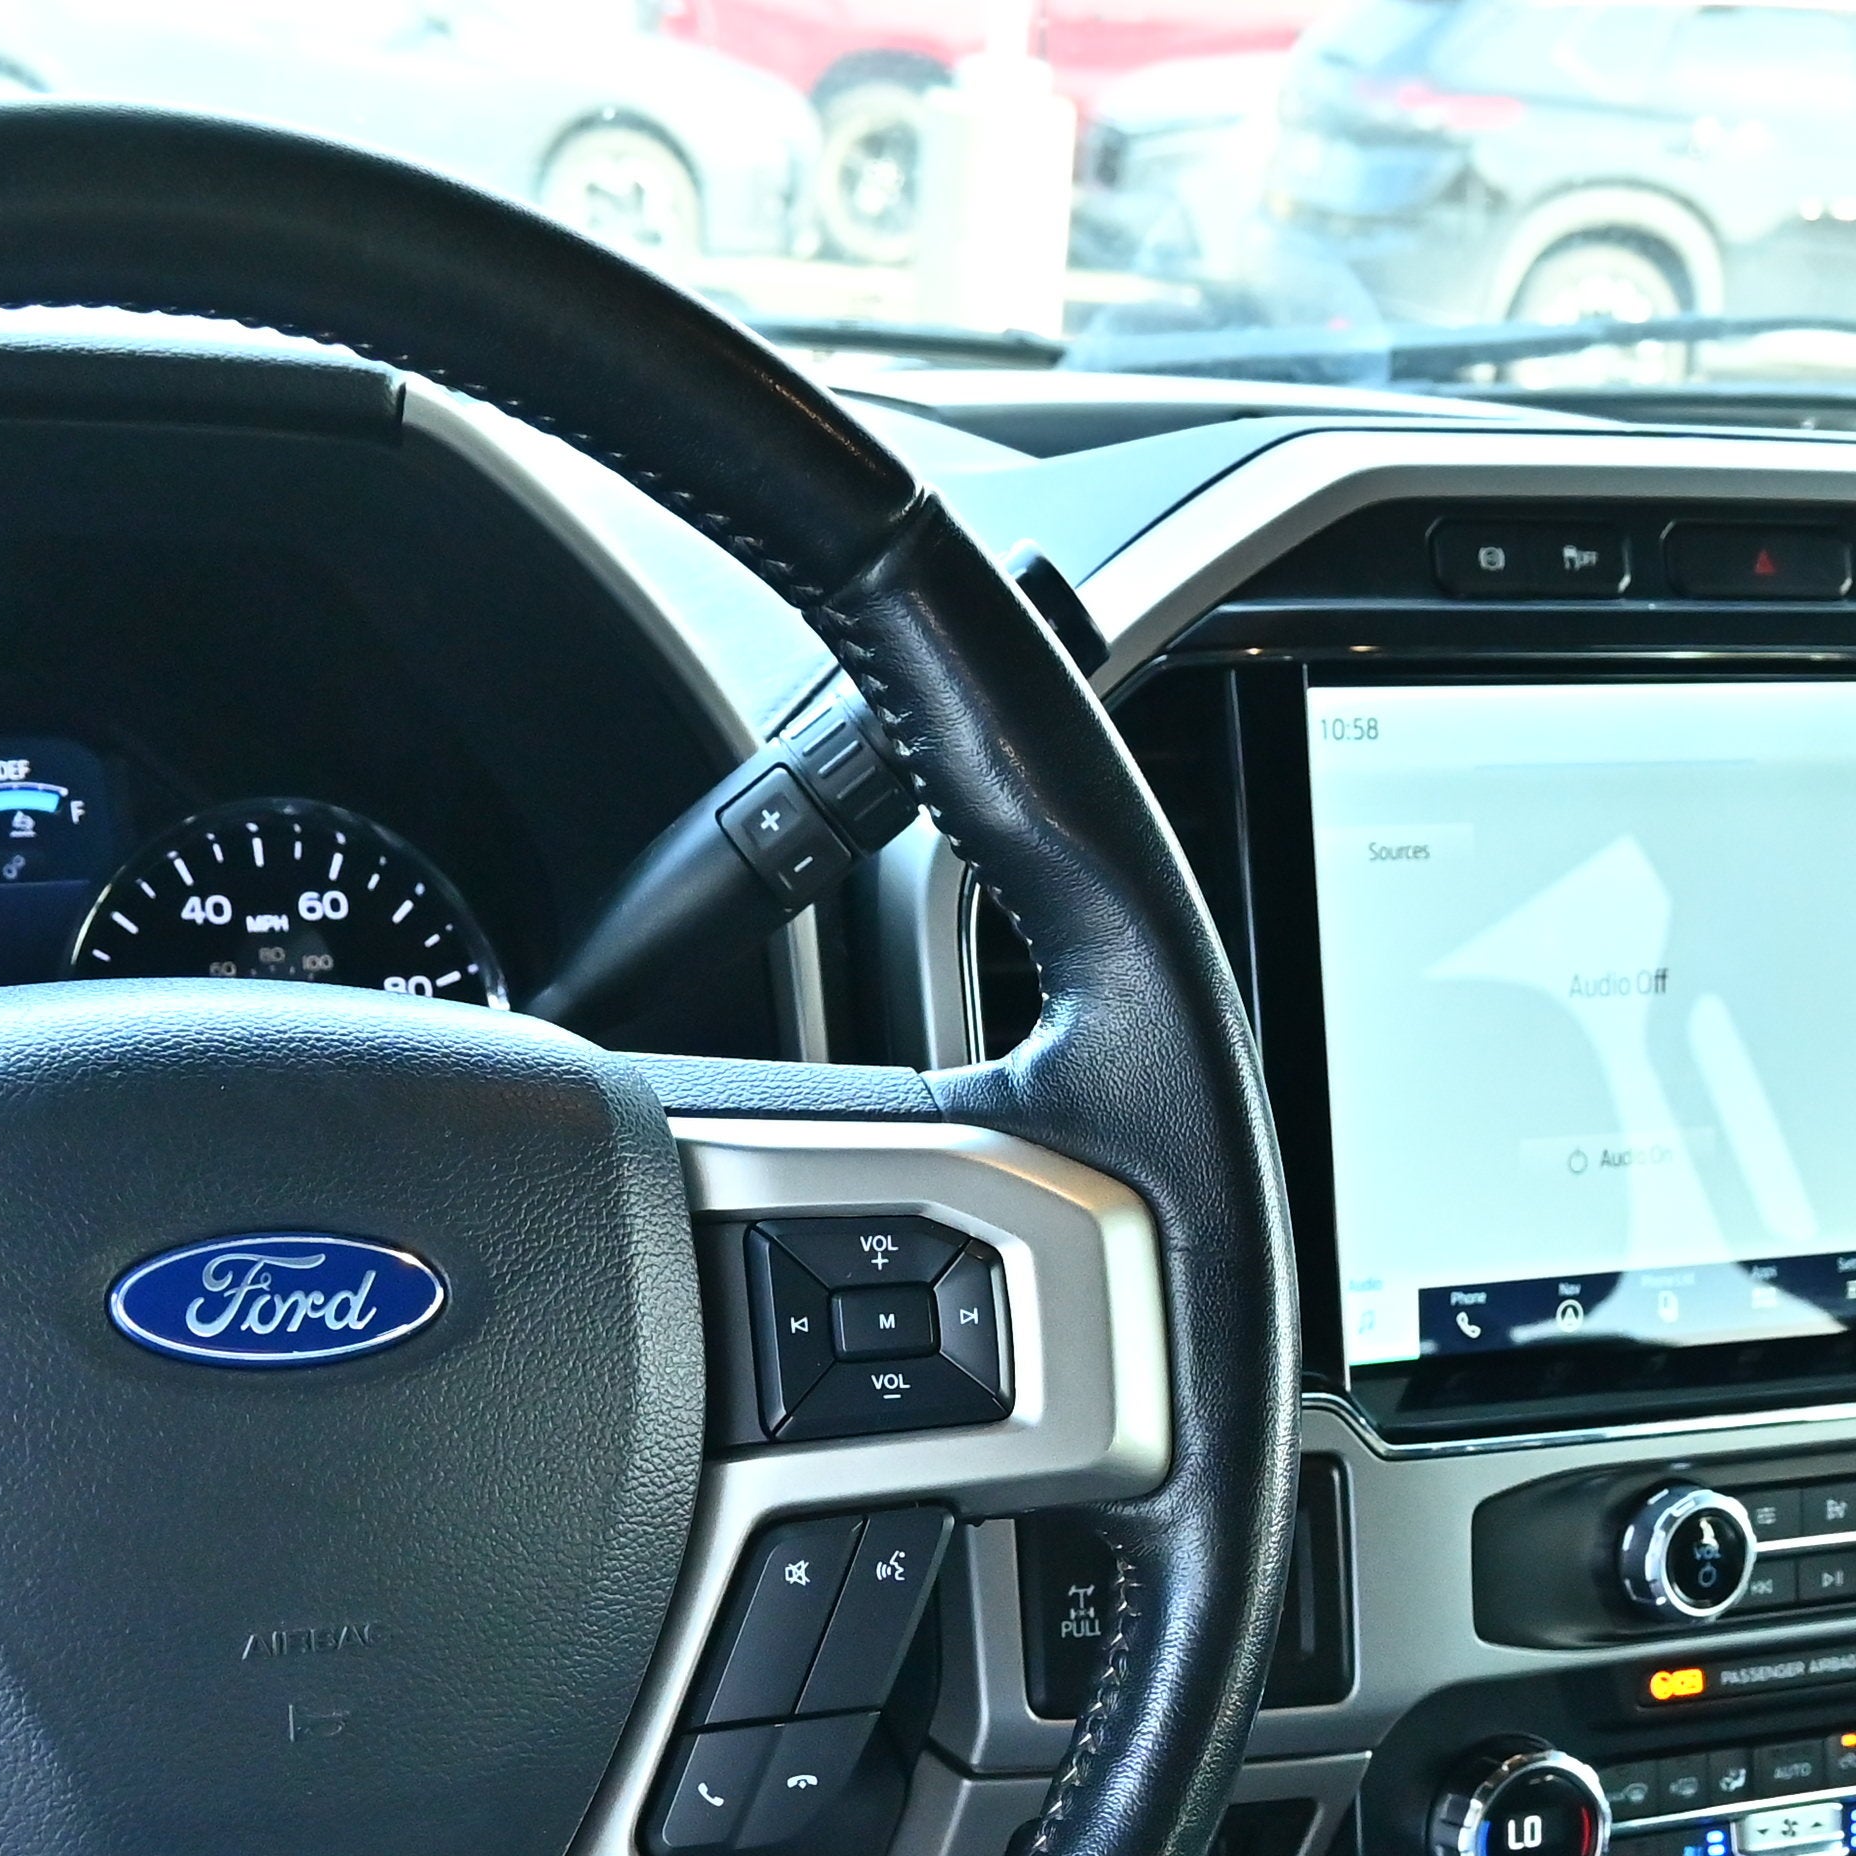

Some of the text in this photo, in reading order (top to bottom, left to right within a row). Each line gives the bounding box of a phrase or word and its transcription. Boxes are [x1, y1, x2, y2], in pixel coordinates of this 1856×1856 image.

[1320, 716, 1380, 741] 10:58
[70, 800, 86, 826] F
[1367, 841, 1431, 862] Sources
[180, 894, 234, 926] 40
[297, 889, 350, 922] 60
[245, 913, 290, 933] MPH
[301, 954, 335, 972] 100
[1568, 967, 1670, 998] Audio Off
[859, 1234, 899, 1252] VOL
[185, 1252, 379, 1338] Ford
[1449, 1290, 1488, 1306] Phone
[878, 1313, 896, 1330] M
[870, 1373, 911, 1390] VOL
[241, 1619, 382, 1661] AIRBAG
[1720, 1659, 1806, 1686] PASSENGER
[1772, 1761, 1813, 1781] AUTO
